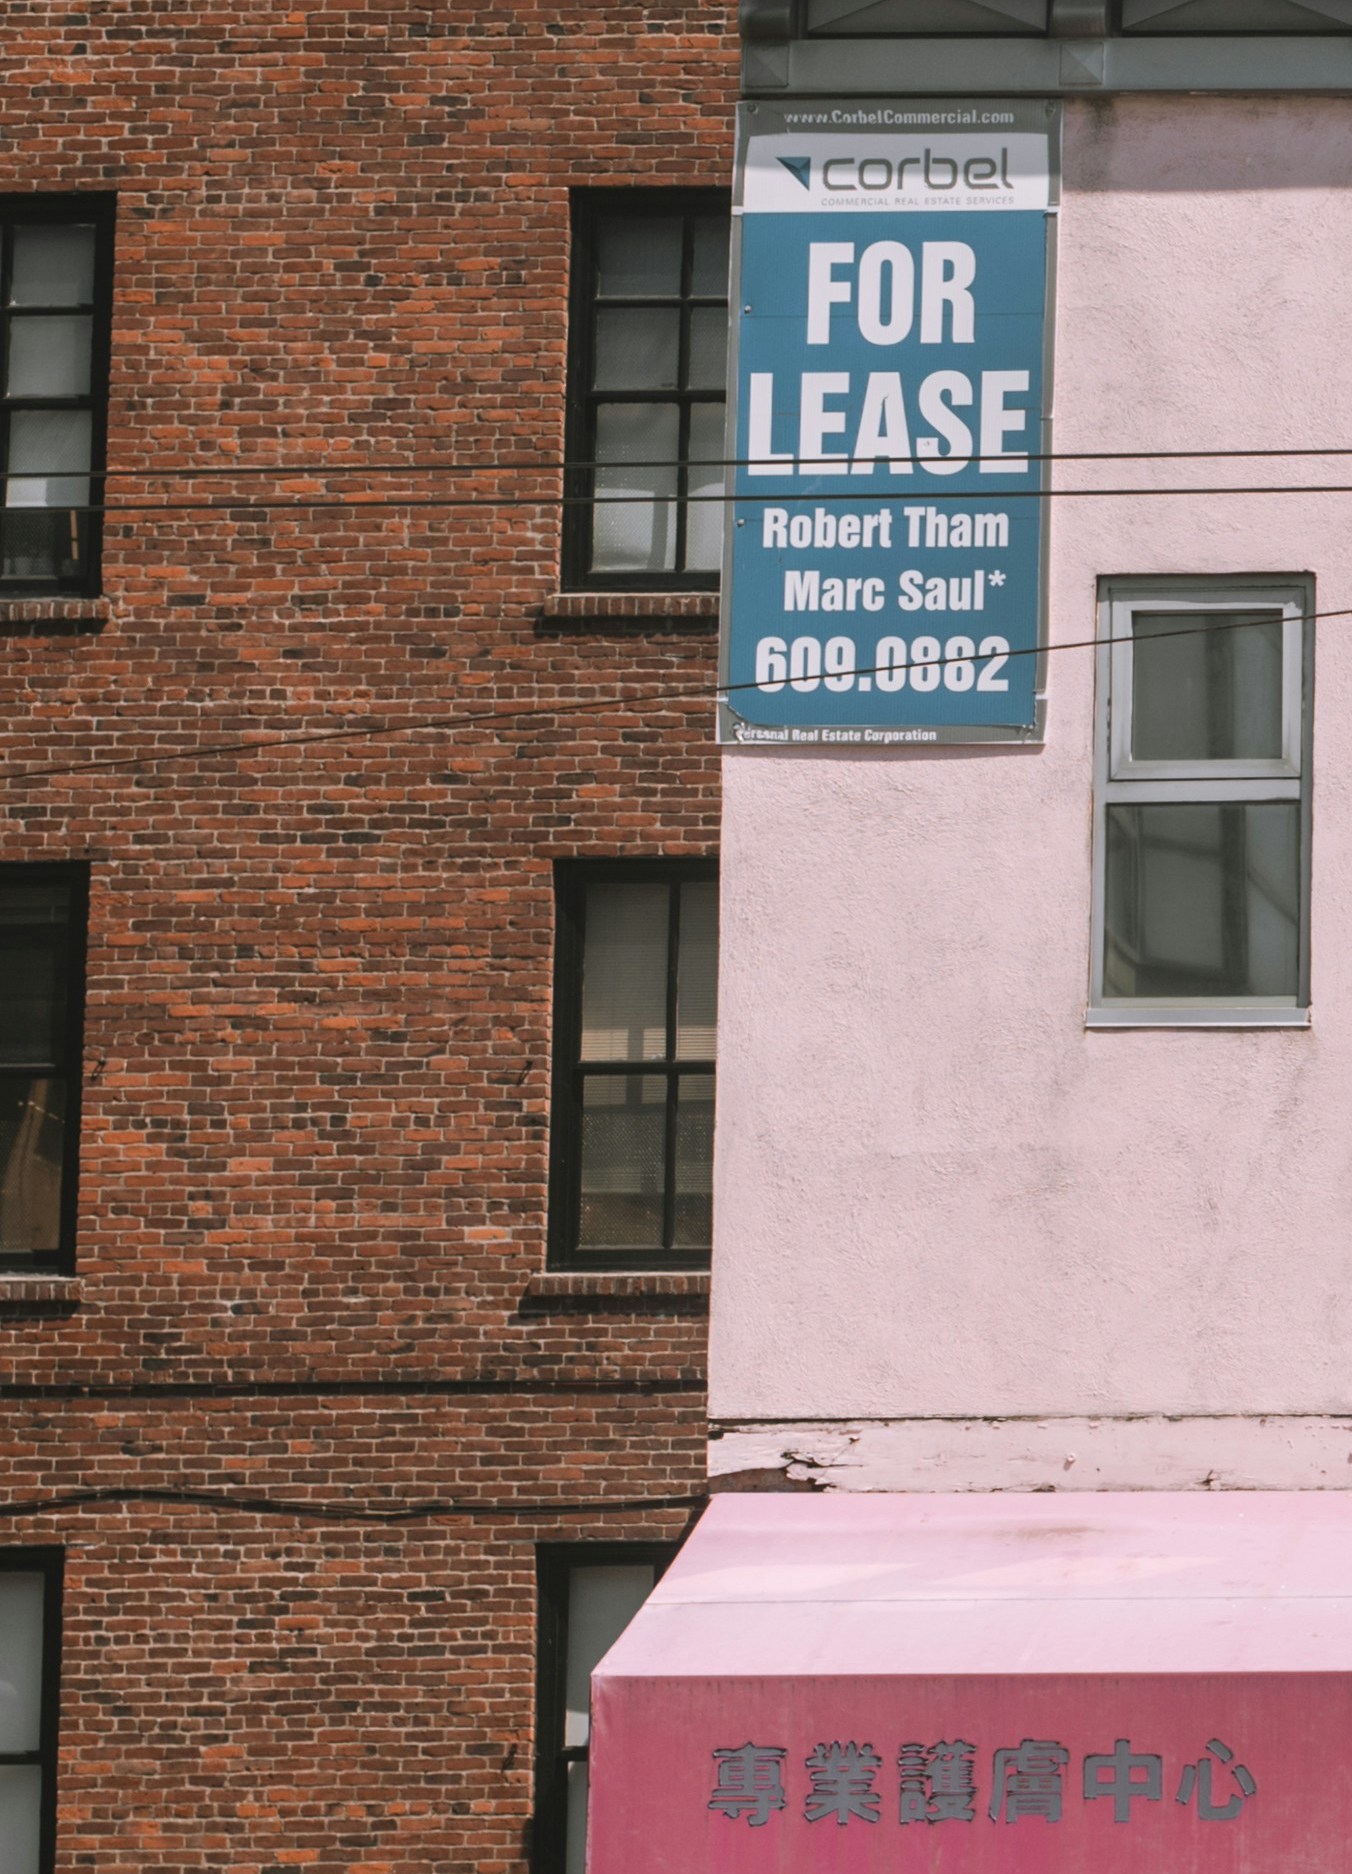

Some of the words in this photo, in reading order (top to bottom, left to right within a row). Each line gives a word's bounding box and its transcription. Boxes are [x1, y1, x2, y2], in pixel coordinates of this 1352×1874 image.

[783, 108, 1015, 125] www.CorbelCommercial.com
[822, 147, 1015, 191] corbel
[820, 197, 890, 207] COMMERCIAL
[894, 197, 919, 206] REAL
[924, 196, 962, 206] ESTATE
[966, 195, 1015, 205] SERVICES
[806, 240, 977, 345] FOR
[747, 370, 1030, 477] LEASE
[762, 506, 893, 549] Robert
[904, 506, 1010, 548] Tham
[783, 569, 885, 613] Marc
[755, 635, 1010, 694] 609.0882
[792, 729, 818, 741] Real
[821, 729, 862, 741] Estate
[864, 729, 937, 743] Corporation
[707, 1737, 1258, 1827] 專業護膚中心
